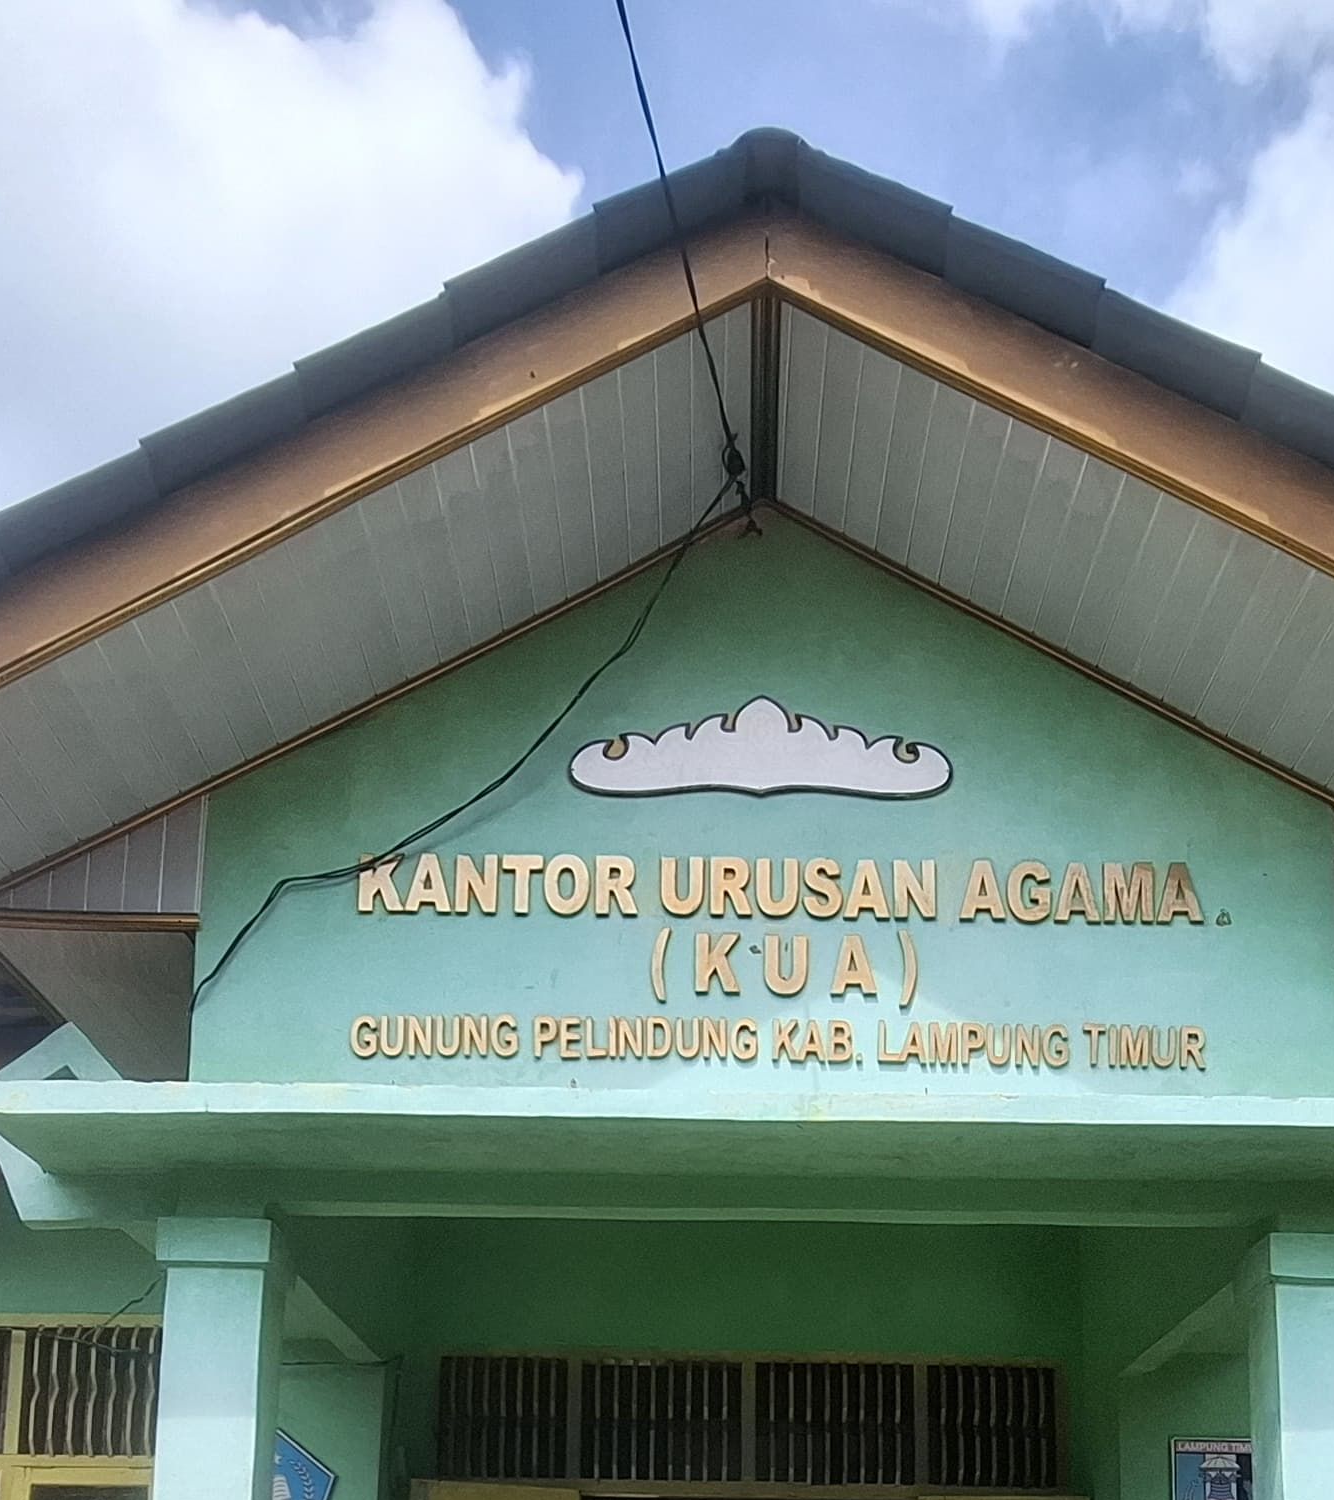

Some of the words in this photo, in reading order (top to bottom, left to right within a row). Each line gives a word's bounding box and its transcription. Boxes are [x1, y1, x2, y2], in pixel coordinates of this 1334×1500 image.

[357, 854, 637, 917] KANTOR
[660, 855, 936, 920] URUSAN
[959, 860, 1204, 925] AGAMA
[350, 1014, 518, 1058] GUNUNG
[534, 1016, 758, 1062] PELINDUNG
[772, 1018, 863, 1065] KAB.
[877, 1020, 1068, 1068] LAMPUNG
[1083, 1023, 1207, 1070] TIMUR
[1178, 1441, 1228, 1452] LAMPUNG
